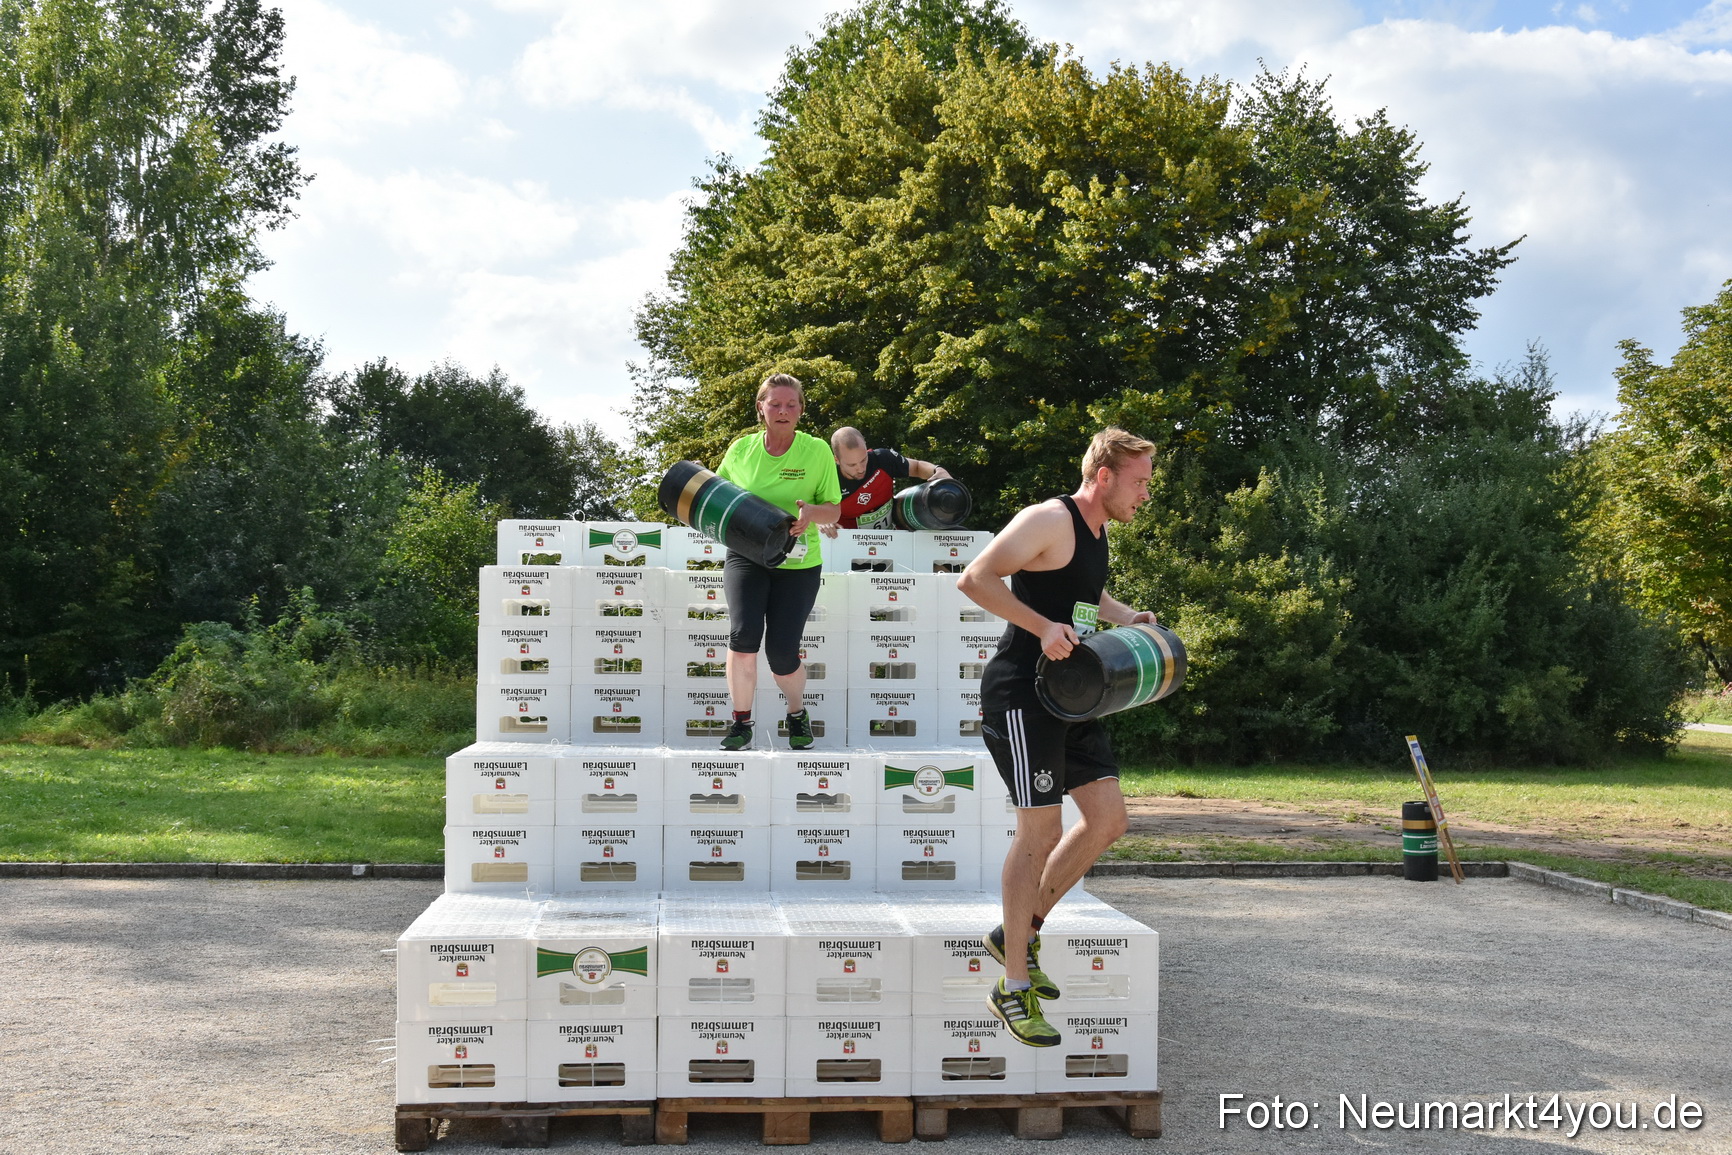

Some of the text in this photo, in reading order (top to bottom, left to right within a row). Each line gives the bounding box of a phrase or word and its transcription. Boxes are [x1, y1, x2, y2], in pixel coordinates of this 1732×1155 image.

[518, 524, 560, 533] Lammsbräu
[852, 534, 892, 542] Lammsbräu
[502, 572, 549, 580] Lammsbräu
[596, 572, 642, 580] Lammsbräu
[870, 578, 916, 586] Lammsbräu
[502, 630, 548, 638] Lammsbräu
[596, 630, 642, 638] Lammsbräu
[870, 635, 916, 644] Lammsbräu
[500, 688, 547, 697] Lammsbräu
[594, 688, 640, 697] Lammsbräu
[870, 692, 916, 701] Lammsbräu
[473, 762, 528, 770] Lammsbräu
[582, 762, 636, 770] Lammsbräu
[692, 762, 744, 770] Lammsbräu
[798, 762, 850, 770] Lammsbräu
[472, 830, 527, 840] Lammsbräu
[582, 830, 636, 839] Lammsbräu
[690, 830, 744, 839] Lammsbräu
[797, 830, 850, 838] Lammsbräu
[903, 830, 955, 838] Lammsbräu
[692, 940, 755, 950] Lammsbräu
[818, 940, 882, 952] Lammsbräu
[944, 940, 982, 950] msbräu
[1068, 938, 1128, 950] Lammsbräu
[430, 944, 494, 954] Lammsbräu
[690, 1022, 754, 1032] Lammsbräu
[818, 1022, 880, 1032] Lammsbräu
[944, 1020, 1005, 1030] Lammsbräu
[1067, 1018, 1128, 1028] Lammsbräu
[428, 1026, 494, 1036] Lammsbräu
[559, 1024, 624, 1036] Lammsbräu
[436, 1036, 484, 1044] Neumarkter
[567, 1036, 614, 1044] Neumarkter
